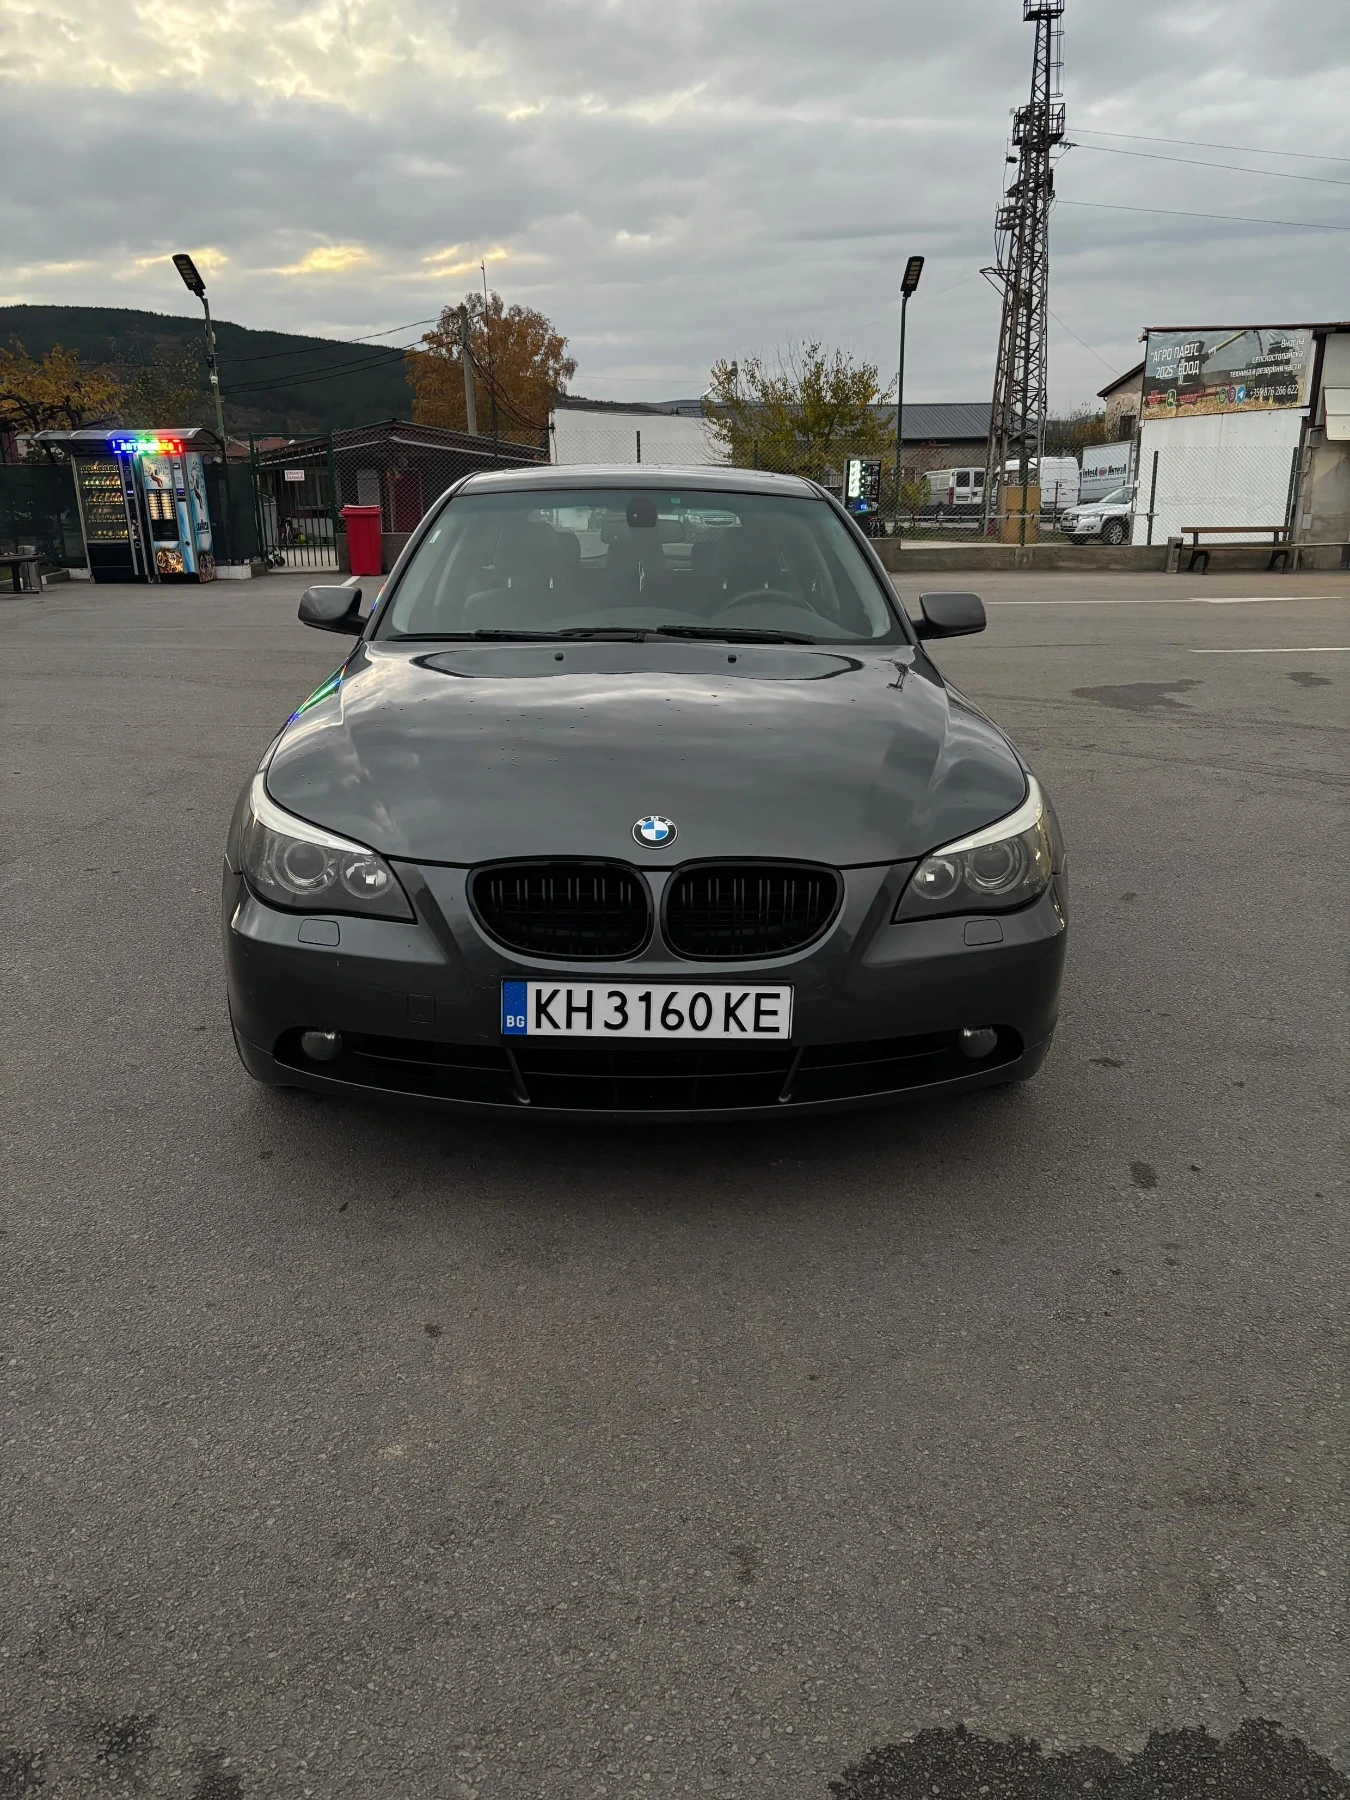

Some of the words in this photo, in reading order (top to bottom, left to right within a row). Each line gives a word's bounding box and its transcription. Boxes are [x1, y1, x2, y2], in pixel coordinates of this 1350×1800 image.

[1174, 343, 1200, 358] ПАРТС
[1178, 360, 1200, 375] ЕООД
[1230, 369, 1251, 378] техника
[1256, 365, 1283, 377] резервни
[1284, 363, 1302, 372] части
[1250, 387, 1263, 398] +359
[1263, 386, 1274, 397] 876
[1275, 385, 1287, 396] 266
[1287, 384, 1299, 395] 622
[506, 1014, 525, 1028] BG
